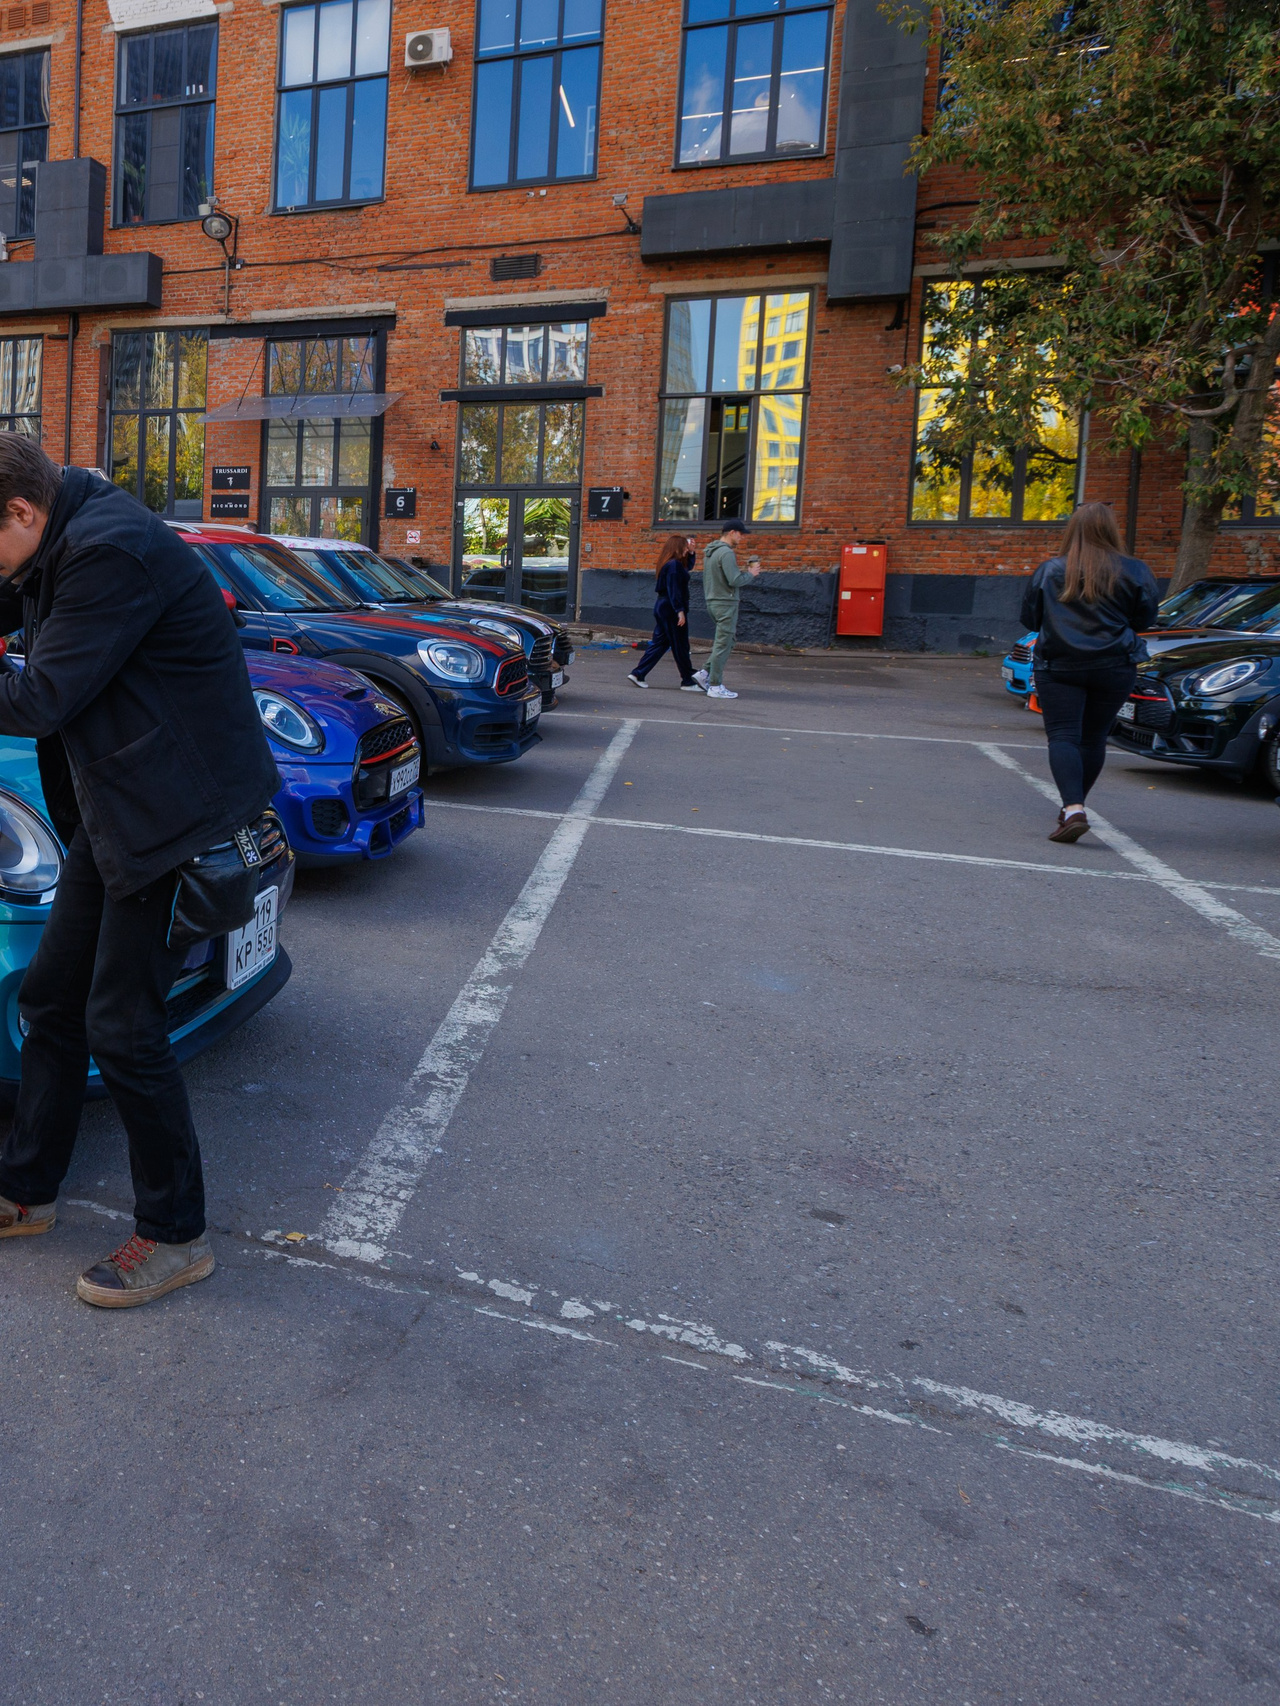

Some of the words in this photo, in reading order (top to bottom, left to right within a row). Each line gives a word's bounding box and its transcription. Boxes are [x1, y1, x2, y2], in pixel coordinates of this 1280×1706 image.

[396, 495, 405, 508] 6
[601, 496, 611, 508] 7
[257, 926, 274, 953] 550
